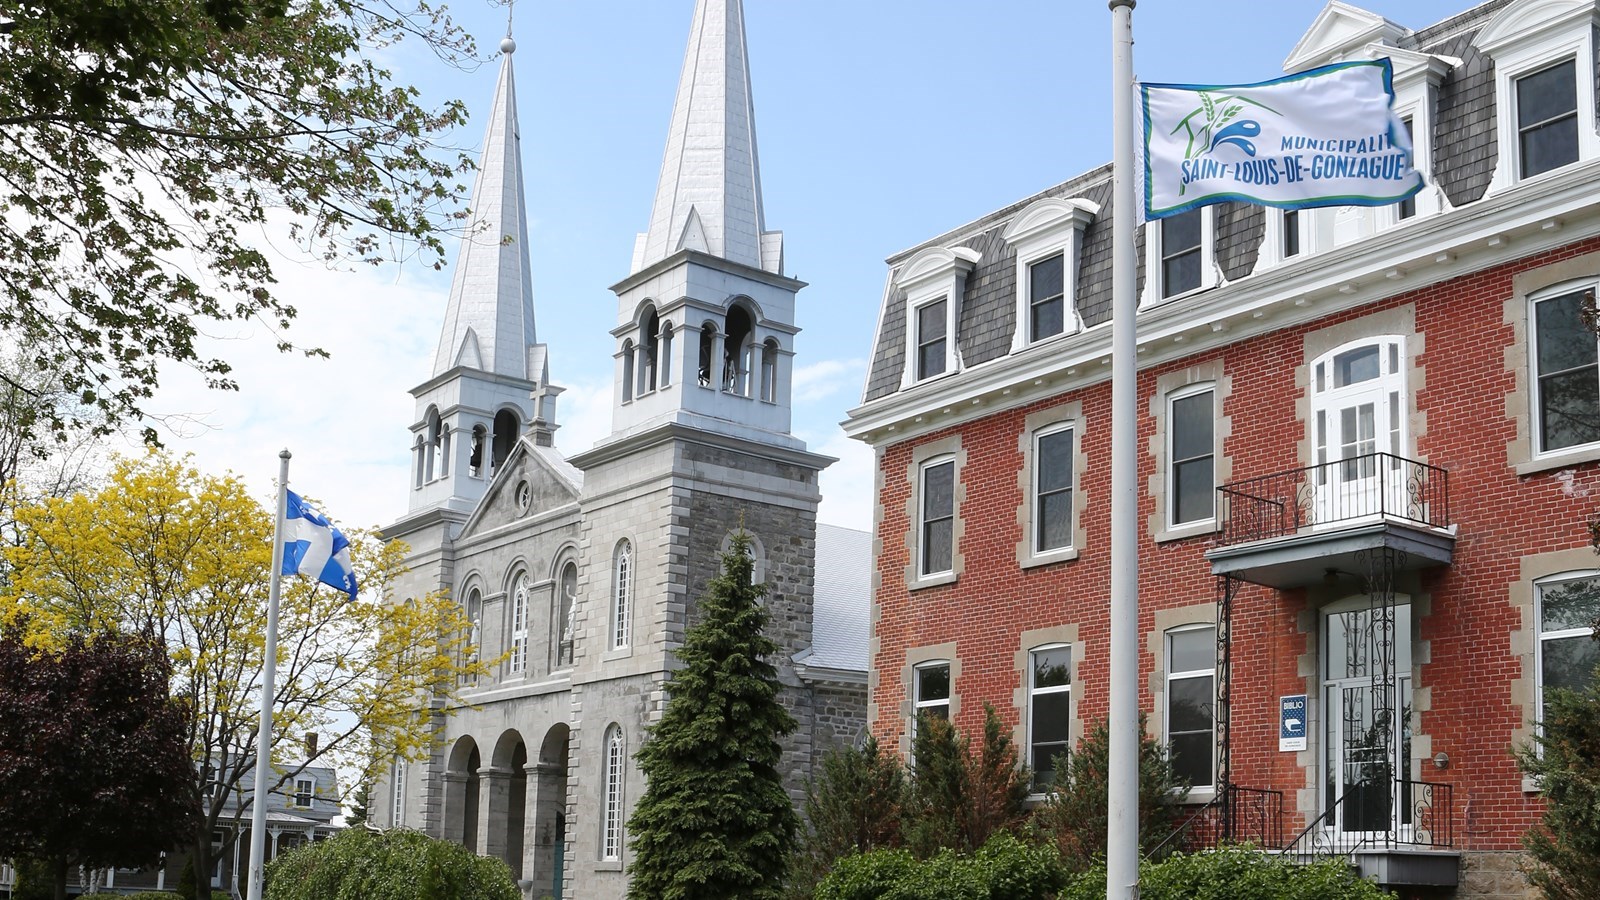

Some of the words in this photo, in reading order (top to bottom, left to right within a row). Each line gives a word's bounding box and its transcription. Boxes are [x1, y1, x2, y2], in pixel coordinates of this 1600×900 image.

[1280, 132, 1392, 153] MUNICIPALIT
[1181, 153, 1405, 186] SAINT-LOUIS-DE-GONZAGUE
[1283, 701, 1304, 710] BIBLIO
